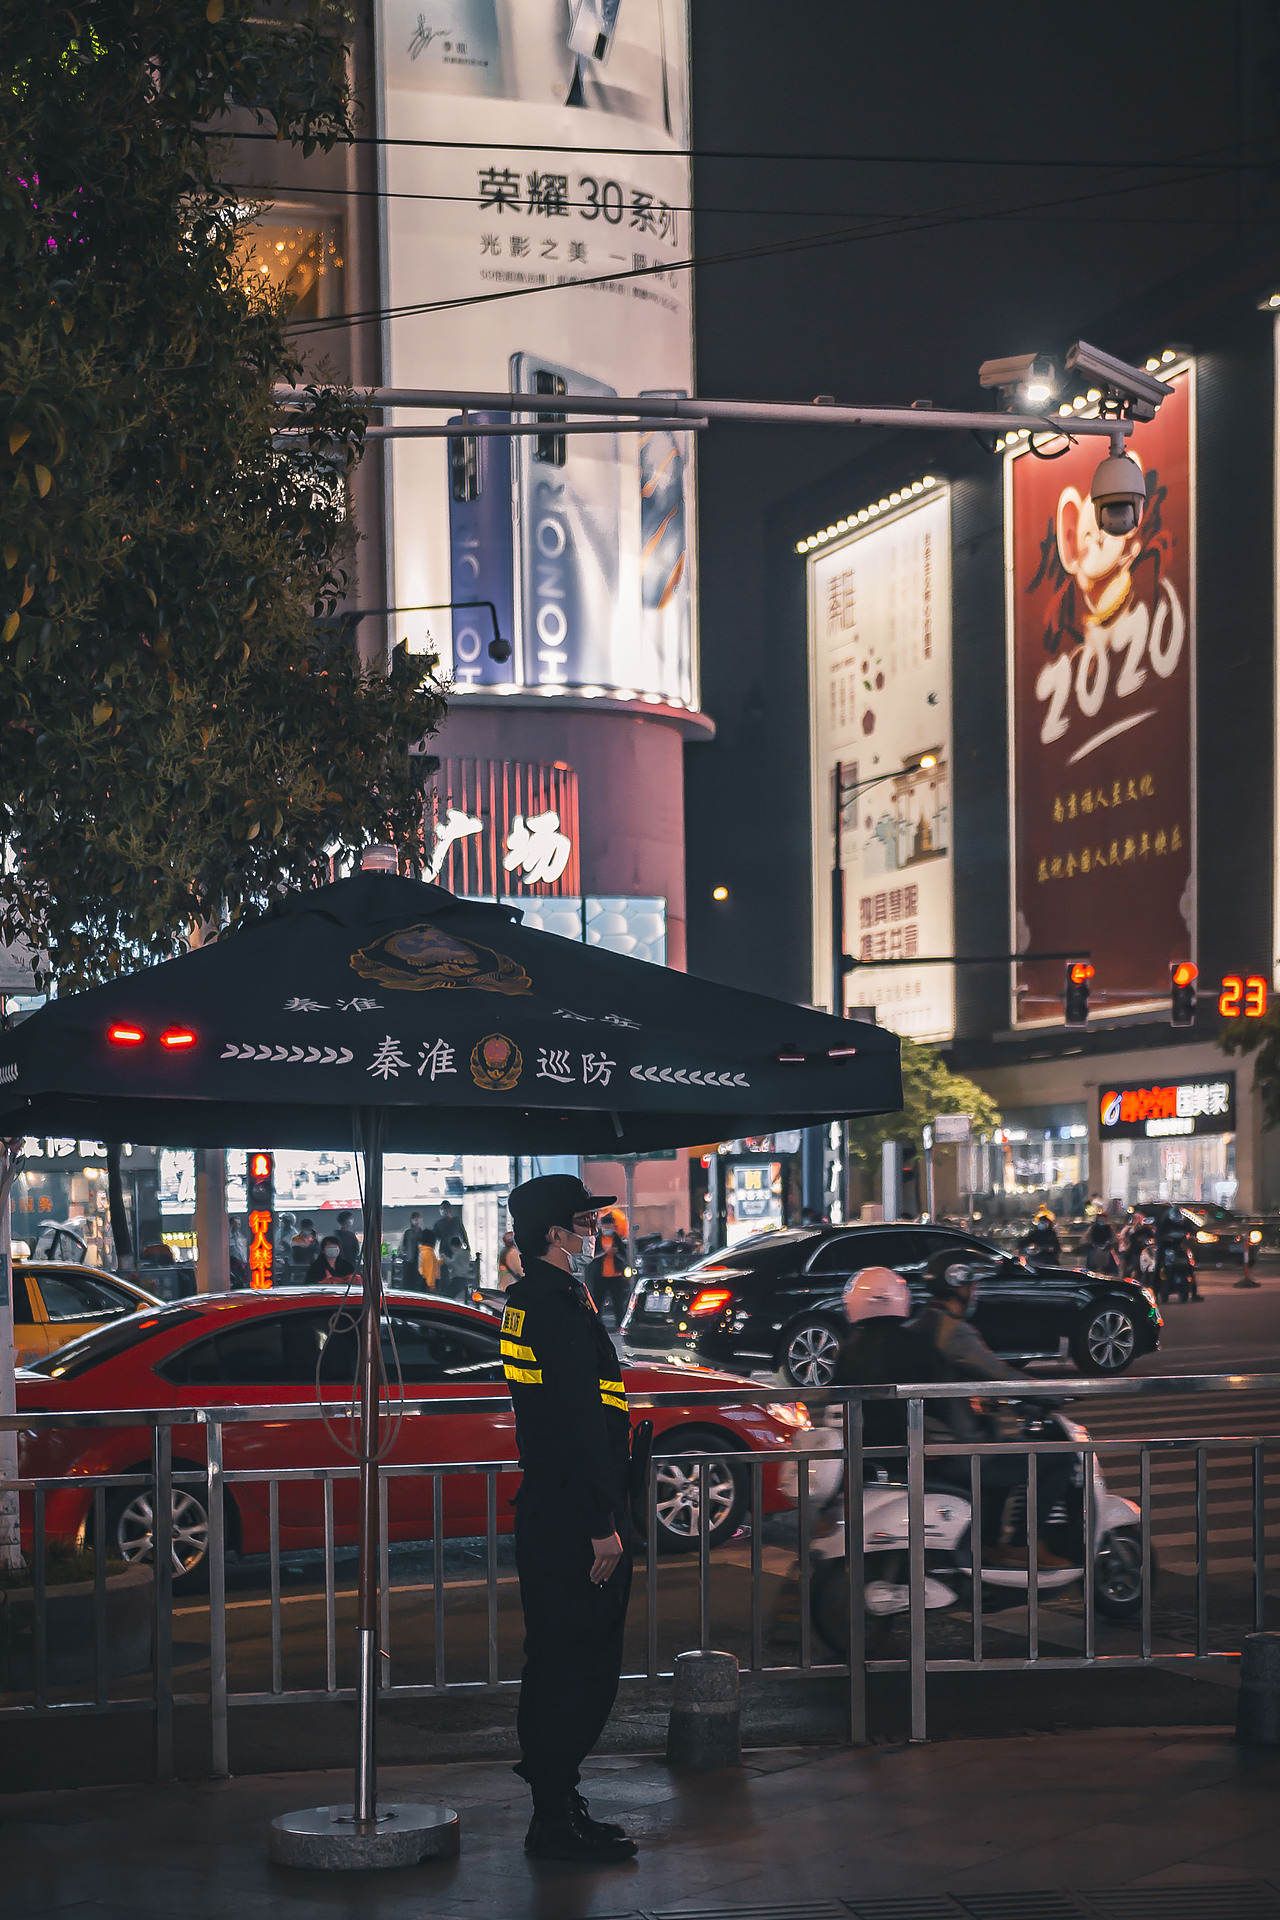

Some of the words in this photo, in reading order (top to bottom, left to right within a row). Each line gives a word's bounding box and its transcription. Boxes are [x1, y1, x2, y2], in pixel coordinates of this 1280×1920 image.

[479, 232, 588, 265] 光影之美
[1034, 576, 1187, 746] 2020
[421, 807, 571, 886] 广场
[1219, 976, 1268, 1018] 23
[366, 1034, 458, 1082] 秦淮
[535, 1047, 618, 1087] 巡防
[250, 1210, 273, 1290] 行人禁止
